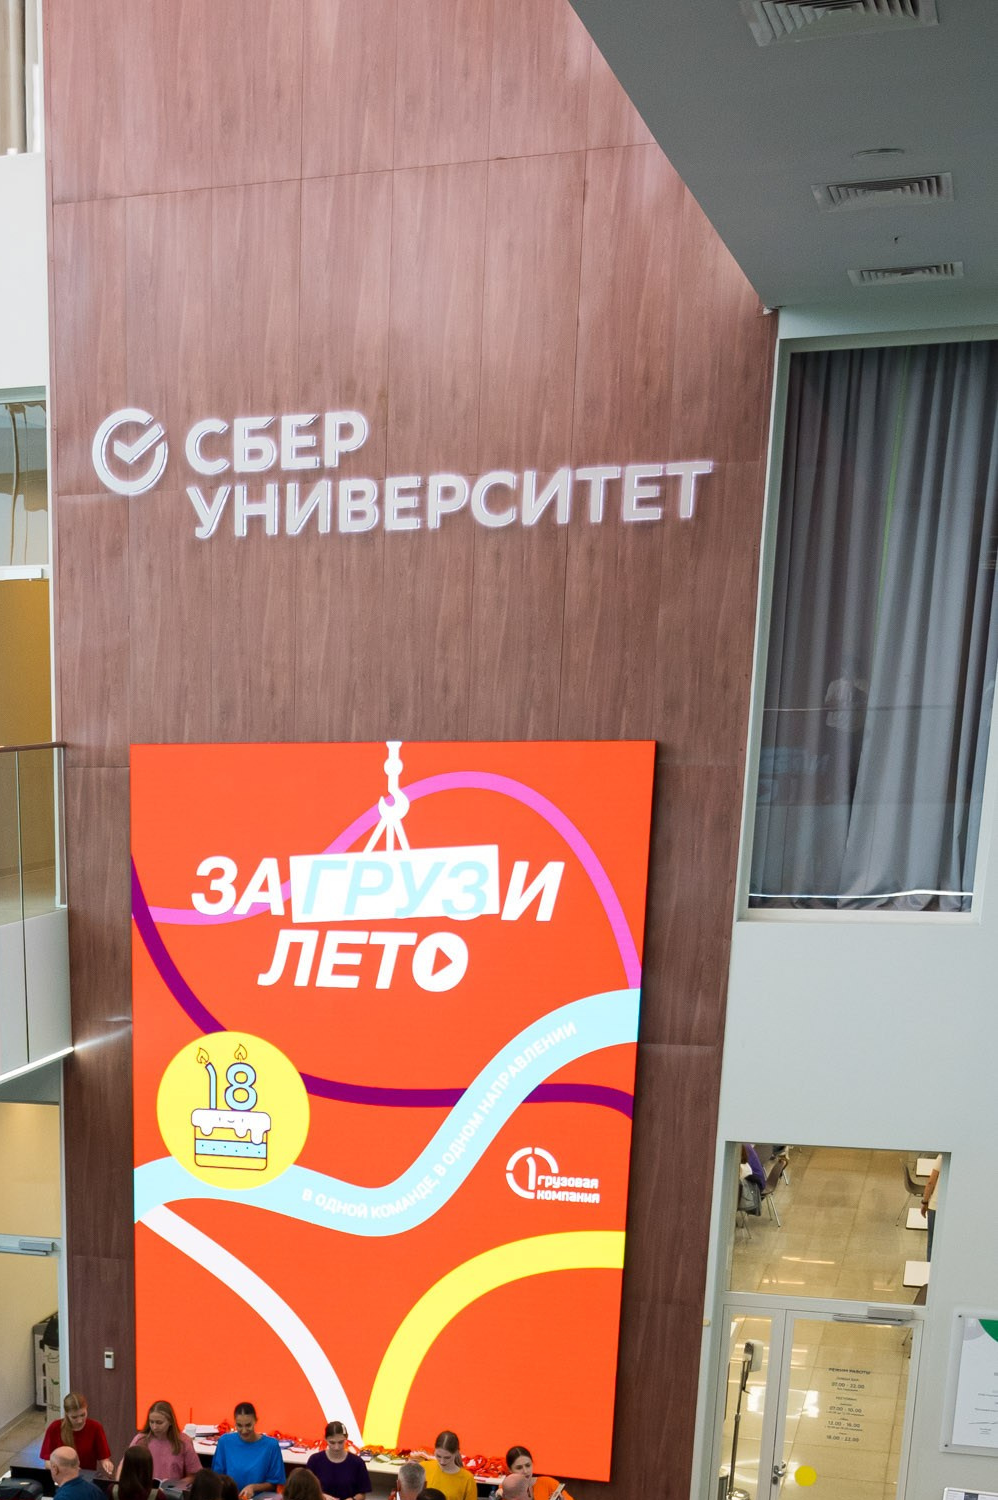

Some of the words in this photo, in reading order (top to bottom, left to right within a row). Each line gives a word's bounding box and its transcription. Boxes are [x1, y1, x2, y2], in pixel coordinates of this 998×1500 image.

[184, 410, 369, 476] СБЕР
[186, 461, 713, 540] УНИВЕРСИТЕТ
[191, 854, 565, 923] ЗАГРУЗИ
[256, 929, 469, 993] ЛЕТО
[302, 1188, 313, 1202] В
[315, 1193, 368, 1219] ОДНОЙ
[371, 1175, 442, 1219] КОМАНДЕ,
[432, 1163, 447, 1177] В
[442, 1110, 485, 1165] ОДНОМ
[477, 1020, 578, 1116] НАПРАВЛЕНИИ
[536, 1189, 601, 1204] компания
[537, 1175, 600, 1189] грузовая
